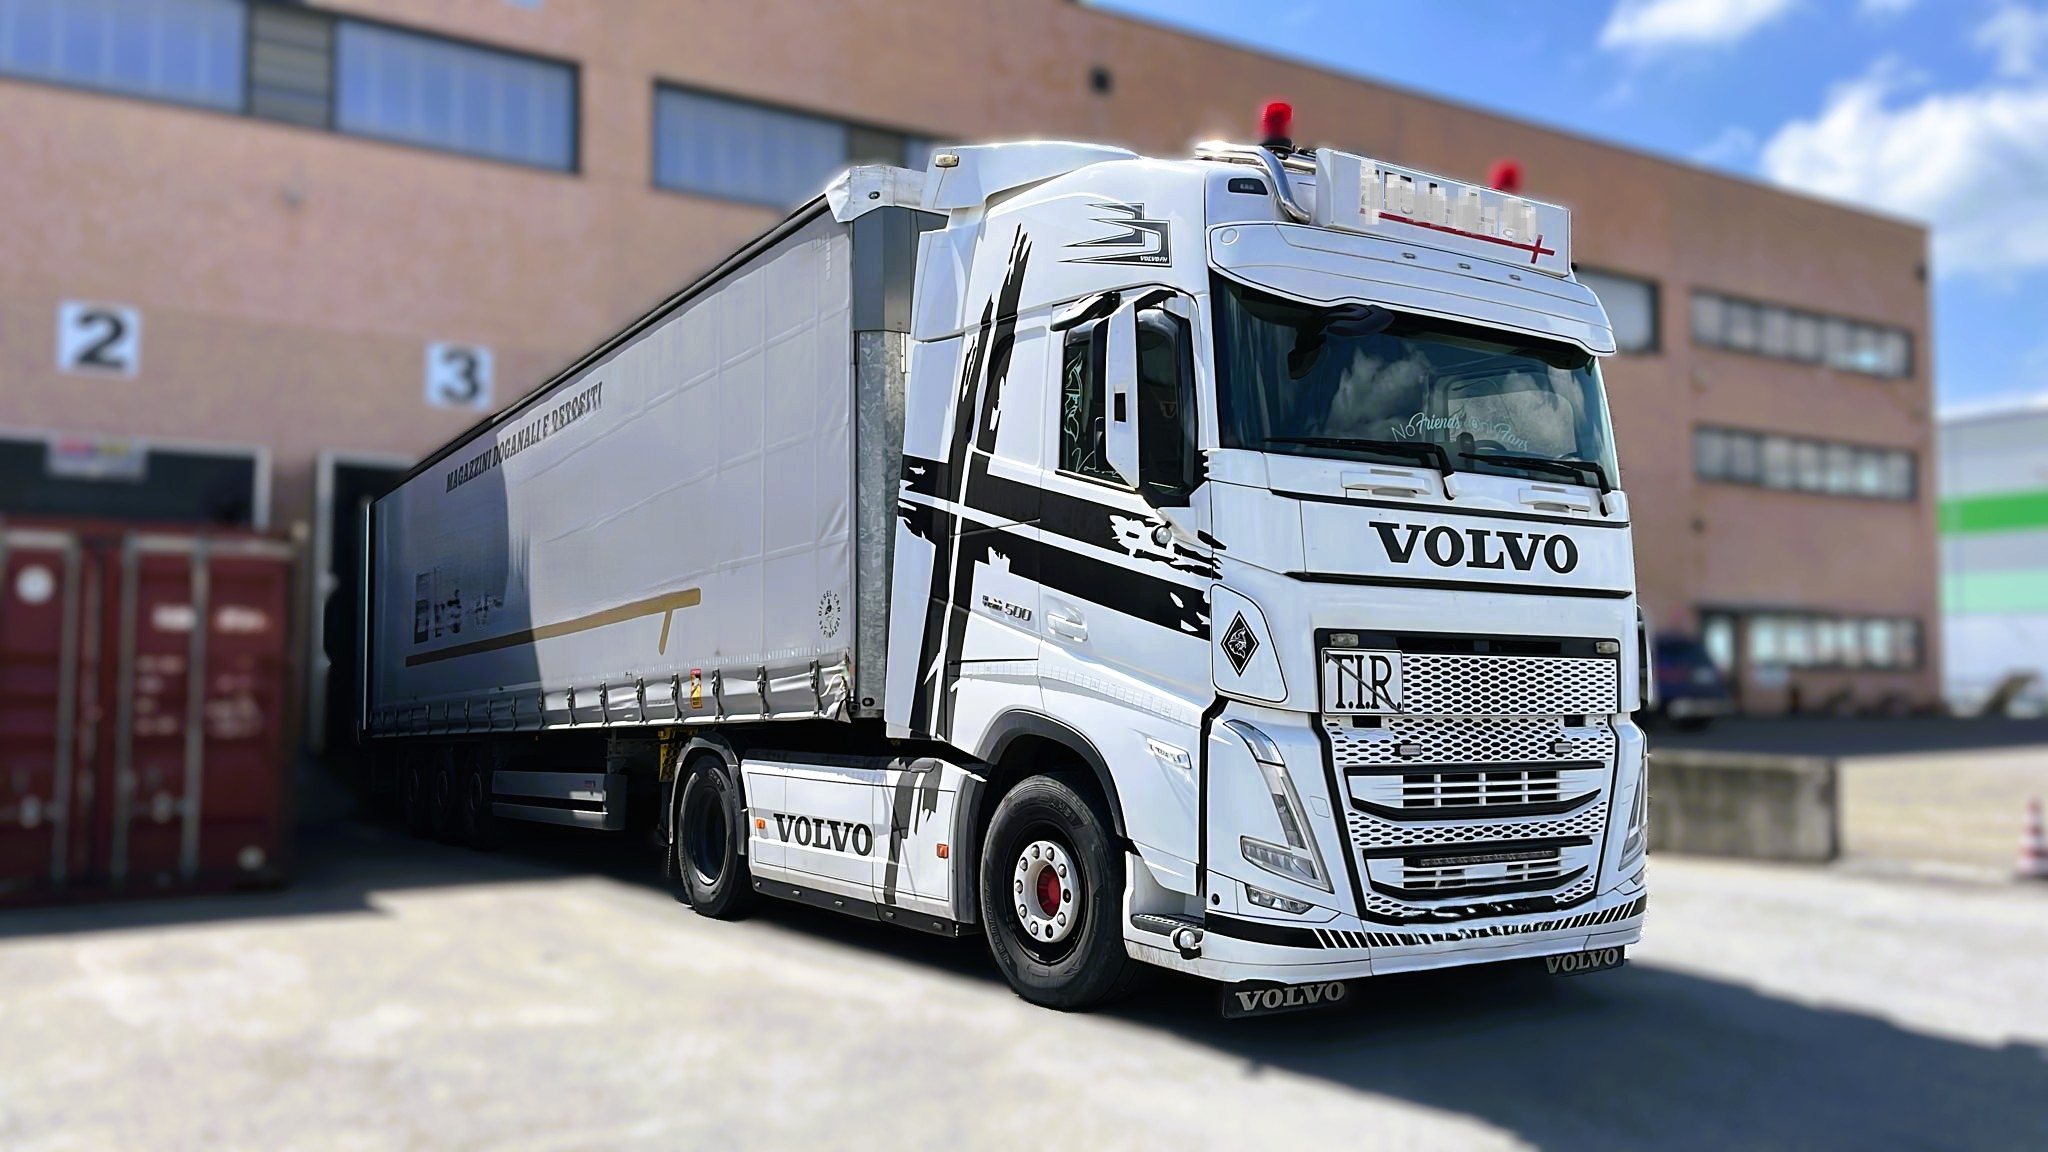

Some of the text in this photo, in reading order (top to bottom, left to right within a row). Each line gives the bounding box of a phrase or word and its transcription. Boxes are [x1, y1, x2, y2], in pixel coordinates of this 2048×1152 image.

[78, 309, 124, 369] 2
[442, 347, 479, 403] 3
[1409, 412, 1460, 434] Friends
[446, 449, 492, 493] MAGAZZINI
[492, 419, 541, 467] DOGANALI
[1369, 521, 1579, 574] VOLVO
[1004, 602, 1032, 621] 500
[773, 813, 873, 856] VOLVO
[1545, 948, 1619, 974] VOLVO
[1235, 981, 1346, 1011] VOLVO
